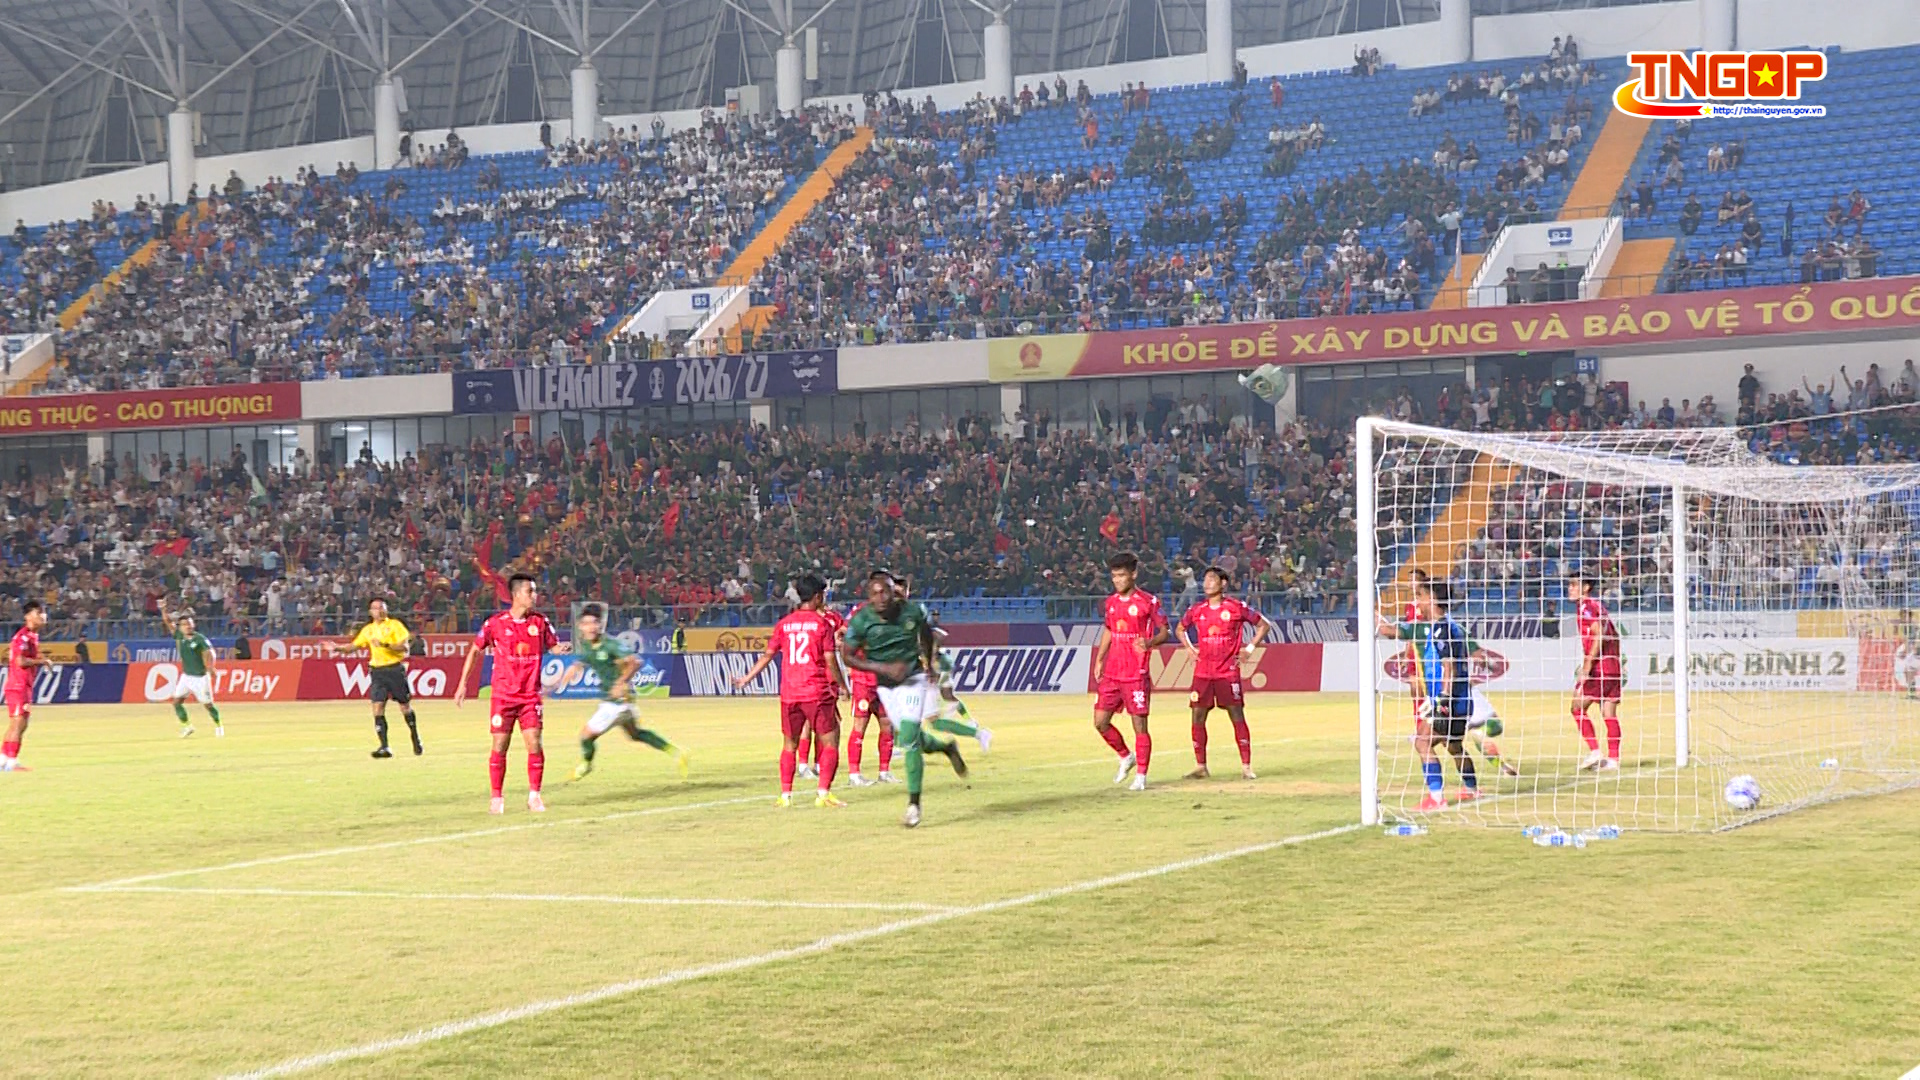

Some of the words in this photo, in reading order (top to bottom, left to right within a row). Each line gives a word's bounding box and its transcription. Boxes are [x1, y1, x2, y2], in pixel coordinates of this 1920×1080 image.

[1122, 333, 1219, 365] KHỎE
[1229, 324, 1279, 360] ĐỂ
[1290, 327, 1372, 356] XÂY
[1383, 320, 1499, 354] DỰNG
[1512, 313, 1571, 342] VÀ
[1583, 303, 1673, 338] BẢO
[1684, 299, 1741, 335] VỆ
[1754, 286, 1815, 325] TỔ
[675, 355, 770, 403] 2026/27
[1578, 359, 1595, 371] B1
[37, 403, 98, 429] THỰC
[116, 401, 165, 422] CAO
[169, 395, 273, 421] THƯỢNG!
[432, 641, 469, 658] FPT
[788, 632, 810, 665] 12
[1827, 651, 1847, 676] 2
[228, 668, 281, 700] Play
[335, 662, 447, 697] Wka
[541, 658, 604, 694] Opa
[952, 648, 1078, 692] FESTIVAL!
